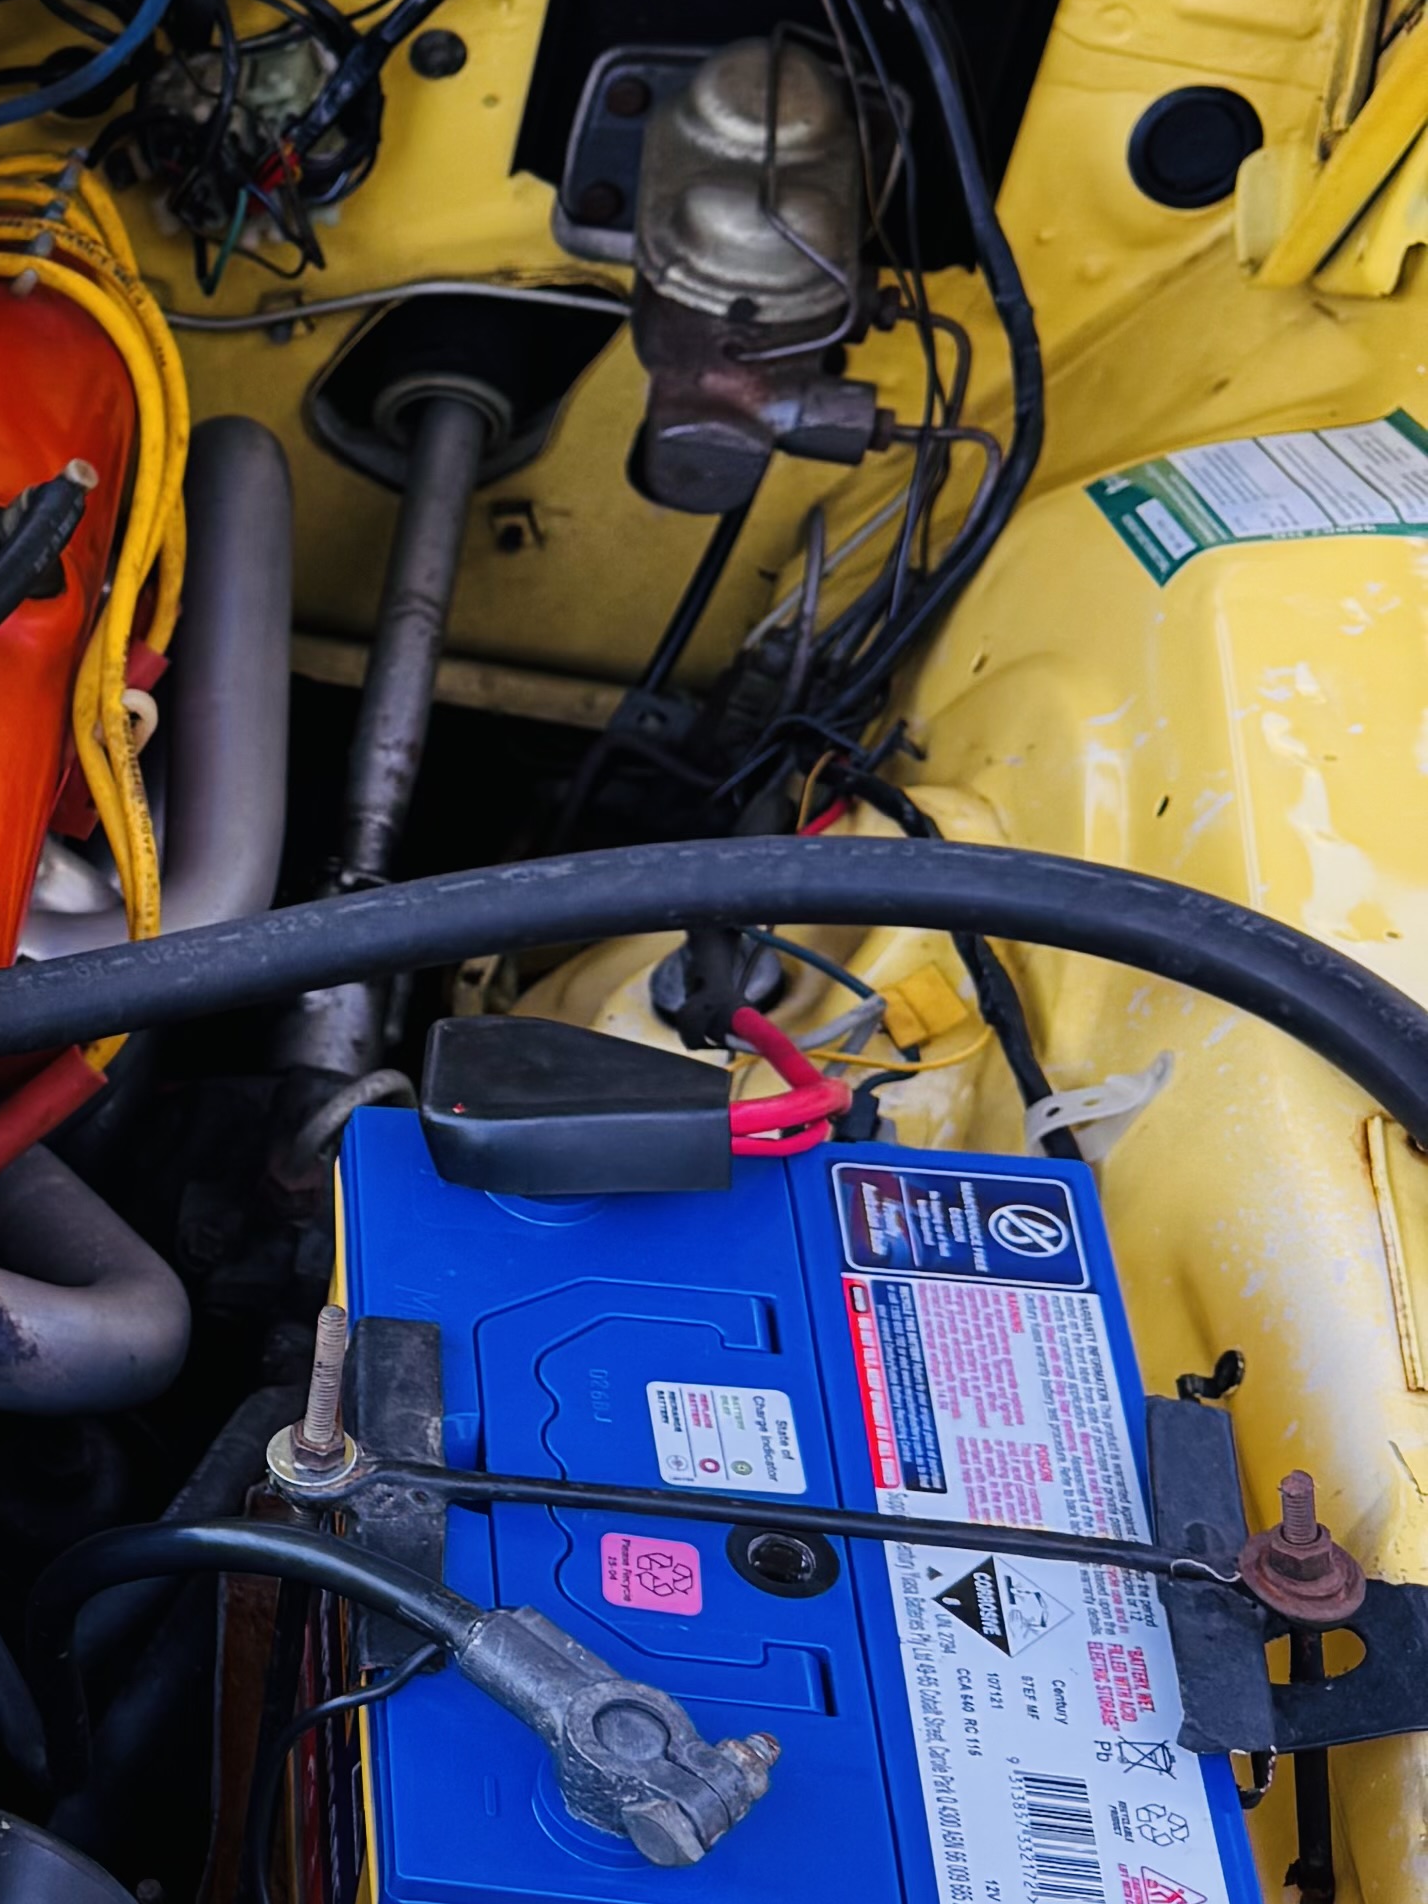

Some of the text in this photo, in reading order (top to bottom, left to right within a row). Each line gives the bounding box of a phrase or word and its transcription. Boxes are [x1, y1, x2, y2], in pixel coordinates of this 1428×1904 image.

[656, 1390, 669, 1423] BATTERY
[688, 1392, 700, 1427] BATTERY
[751, 1395, 778, 1482] Charge Indicator
[775, 1420, 793, 1460] State of
[1033, 1443, 1054, 1482] POISON
[620, 1539, 633, 1601] Please Recycle
[894, 1544, 919, 1569] entury
[898, 1571, 923, 1594] Yuasa
[902, 1596, 929, 1631] Batteries
[972, 1572, 1001, 1635] CORROSIVE
[910, 1647, 934, 1661] Ltd
[1086, 1641, 1110, 1682] ELECTRIC
[954, 1667, 972, 1691] CCA
[963, 1717, 979, 1733] RC
[985, 1671, 1004, 1709] 107121
[1106, 1643, 1138, 1722] FILLED WITH ACID
[917, 1688, 943, 1715] Cobalt
[1047, 1679, 1070, 1725] Century
[1093, 1740, 1114, 1762] Pb
[931, 1774, 956, 1794] Park
[984, 1878, 1001, 1902] 12V
